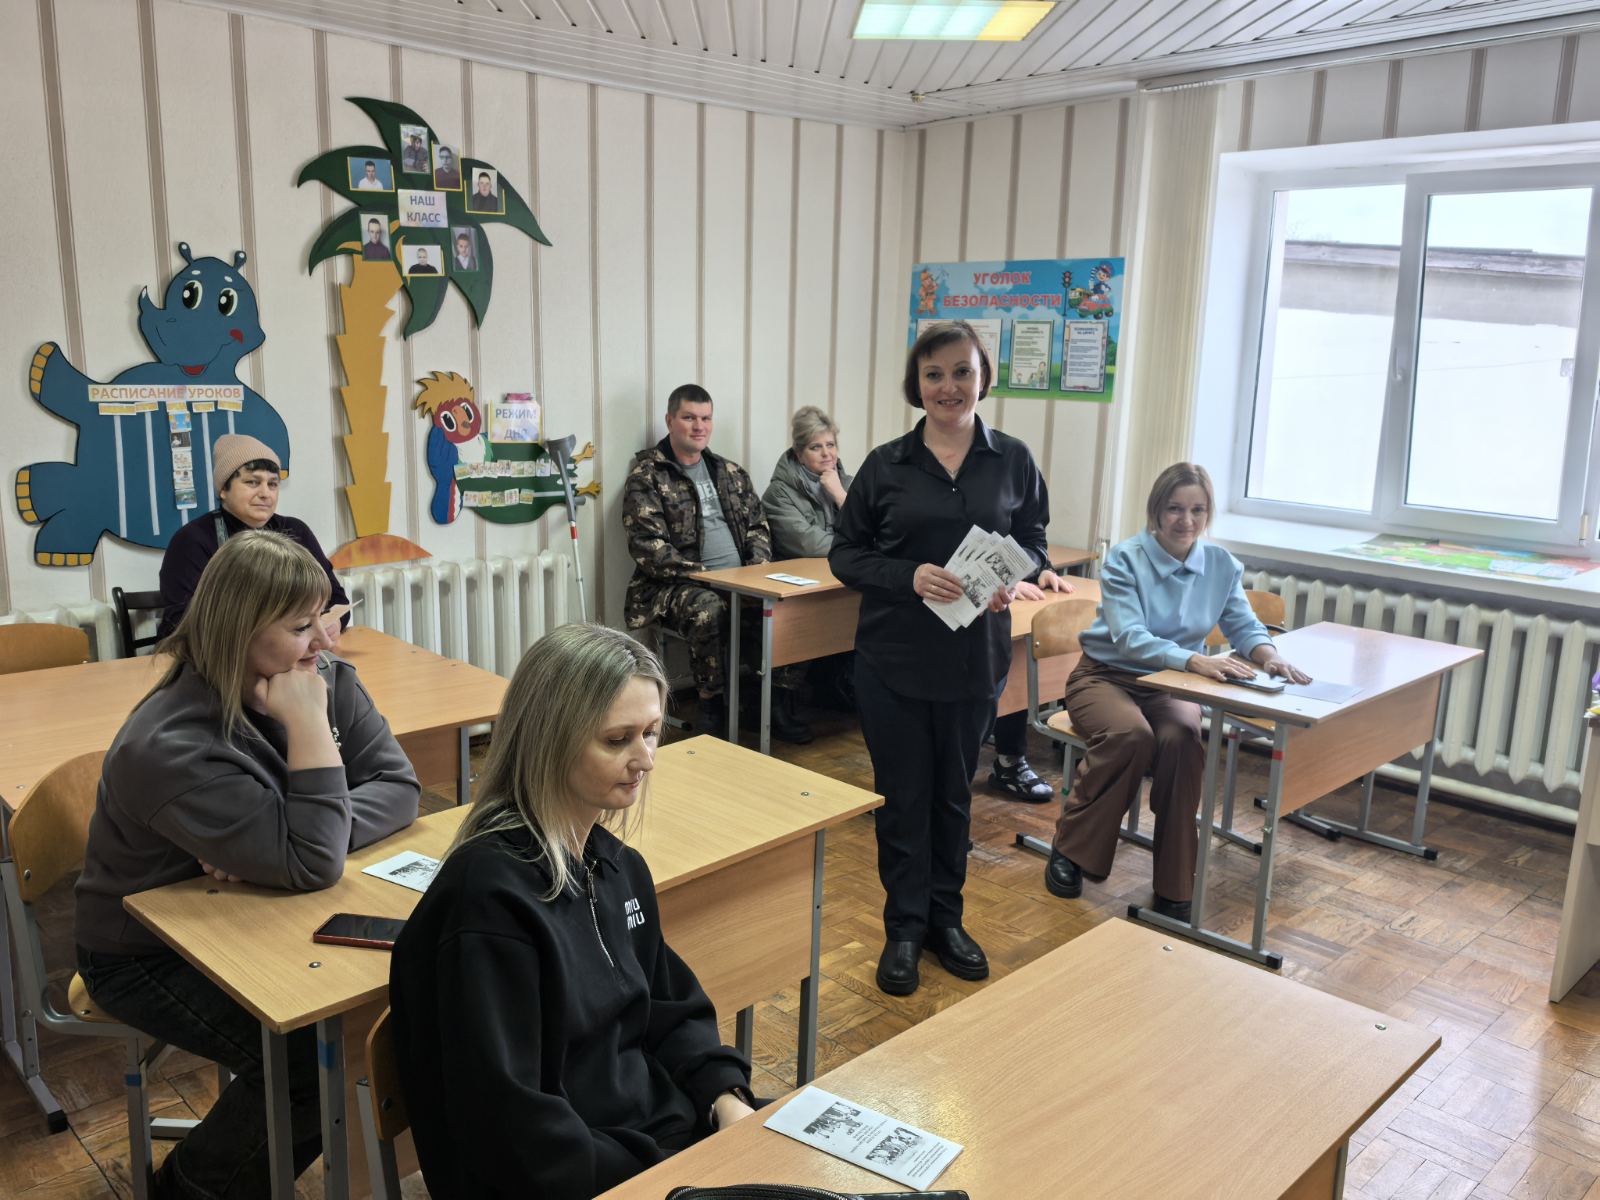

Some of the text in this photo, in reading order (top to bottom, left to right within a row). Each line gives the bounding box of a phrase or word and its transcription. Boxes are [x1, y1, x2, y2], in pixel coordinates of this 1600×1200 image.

[410, 195, 435, 206] НАШ
[407, 211, 441, 223] КЛАСС
[973, 271, 1032, 286] УГОЛОК
[943, 294, 1063, 308] БЕЗОПАСНОСТИ
[91, 386, 241, 399] РАСПИСАНИЕ УРОКОВ
[495, 408, 537, 419] РЕЖИМ
